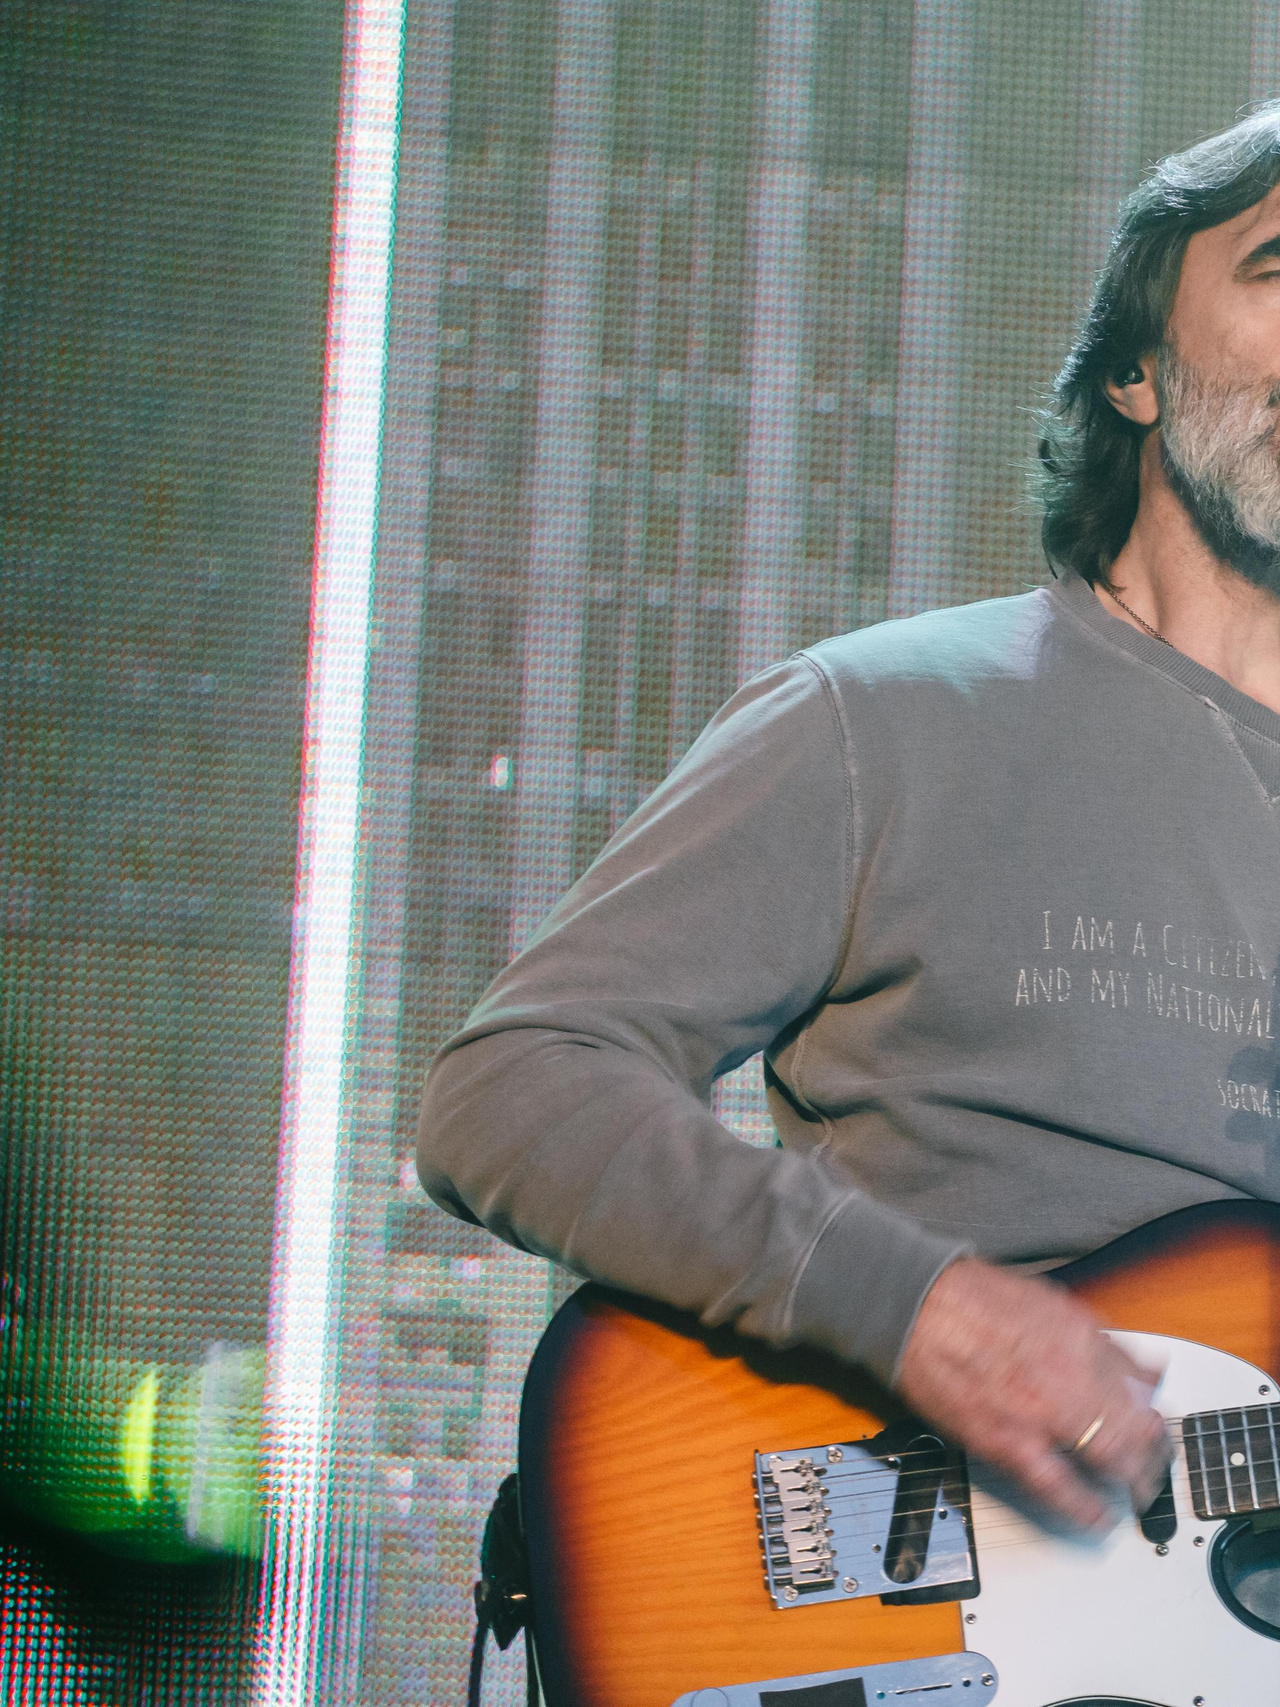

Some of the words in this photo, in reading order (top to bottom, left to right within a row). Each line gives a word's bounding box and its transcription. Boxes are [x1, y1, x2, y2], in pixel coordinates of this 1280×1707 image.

[1042, 910, 1053, 950] I
[1071, 915, 1114, 954] AM
[1132, 921, 1146, 957] A
[1015, 966, 1071, 1006] AND
[1091, 968, 1130, 1008] MY
